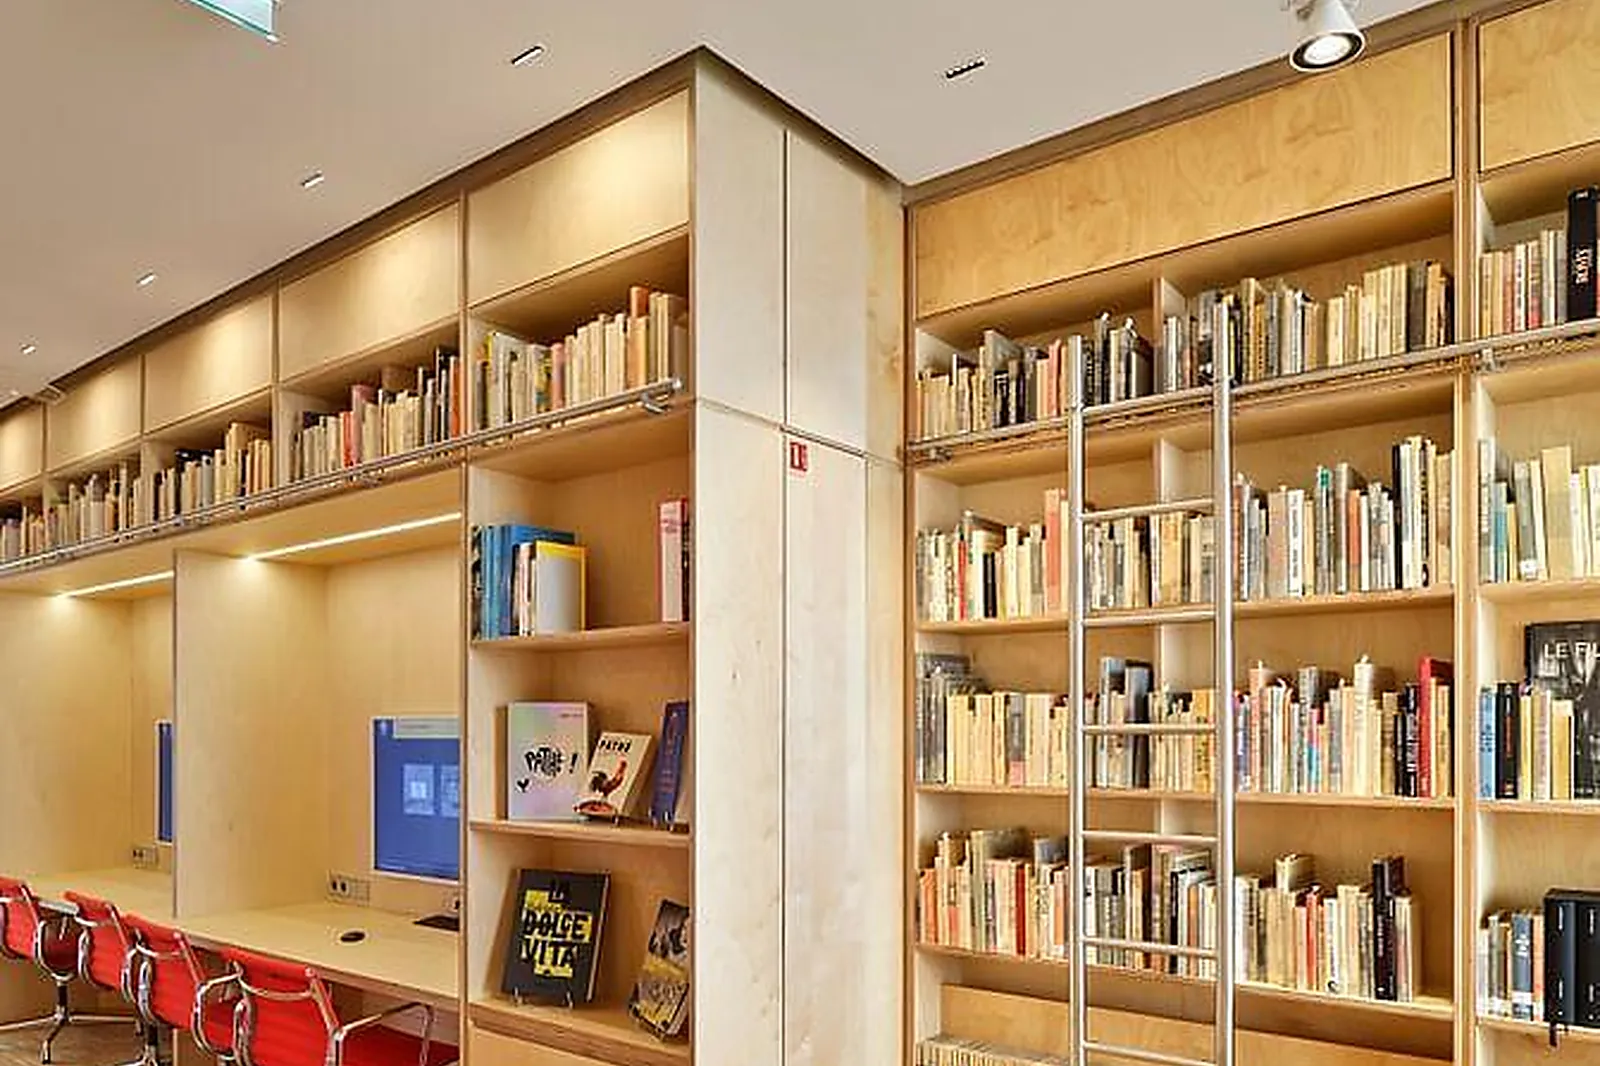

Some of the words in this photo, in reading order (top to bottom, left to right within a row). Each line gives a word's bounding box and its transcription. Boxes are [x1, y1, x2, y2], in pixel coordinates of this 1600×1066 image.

[1544, 642, 1569, 659] LE
[523, 908, 590, 940] DOLCE
[521, 938, 577, 968] VITA
